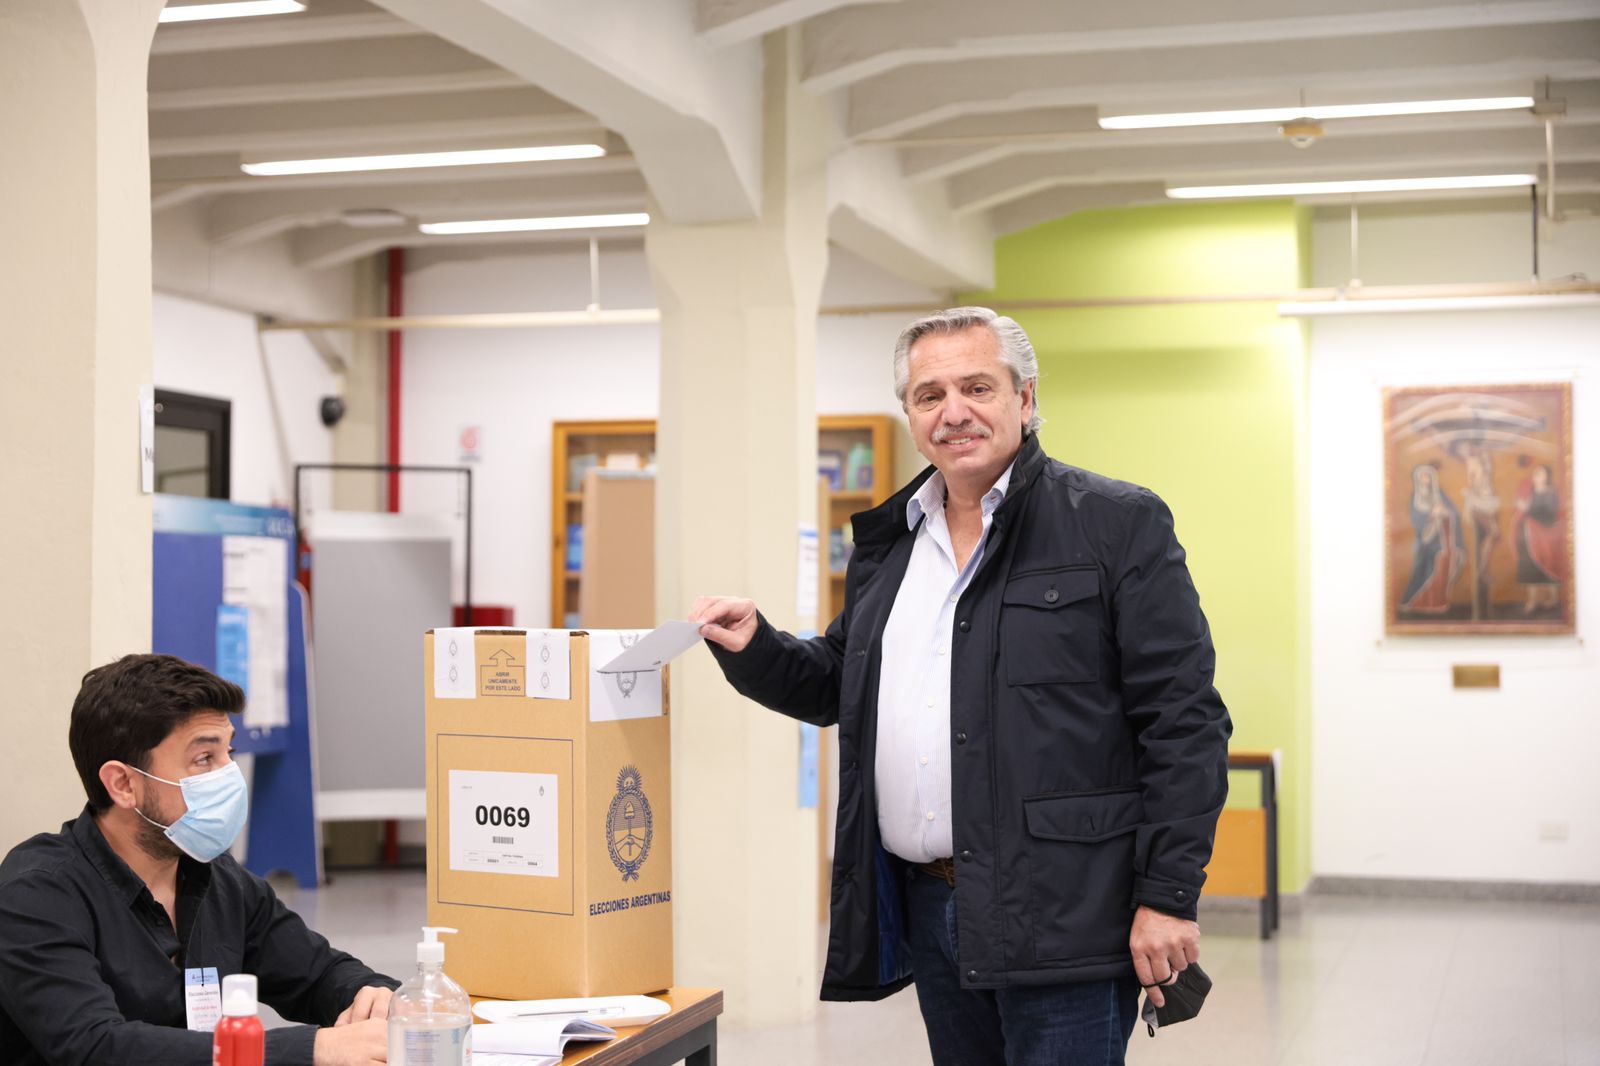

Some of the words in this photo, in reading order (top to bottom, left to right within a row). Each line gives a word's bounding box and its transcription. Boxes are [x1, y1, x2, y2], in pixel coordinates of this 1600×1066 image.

[475, 805, 530, 828] 0069
[589, 898, 629, 916] ELECCIONES
[631, 890, 671, 908] ARGENTINAS
